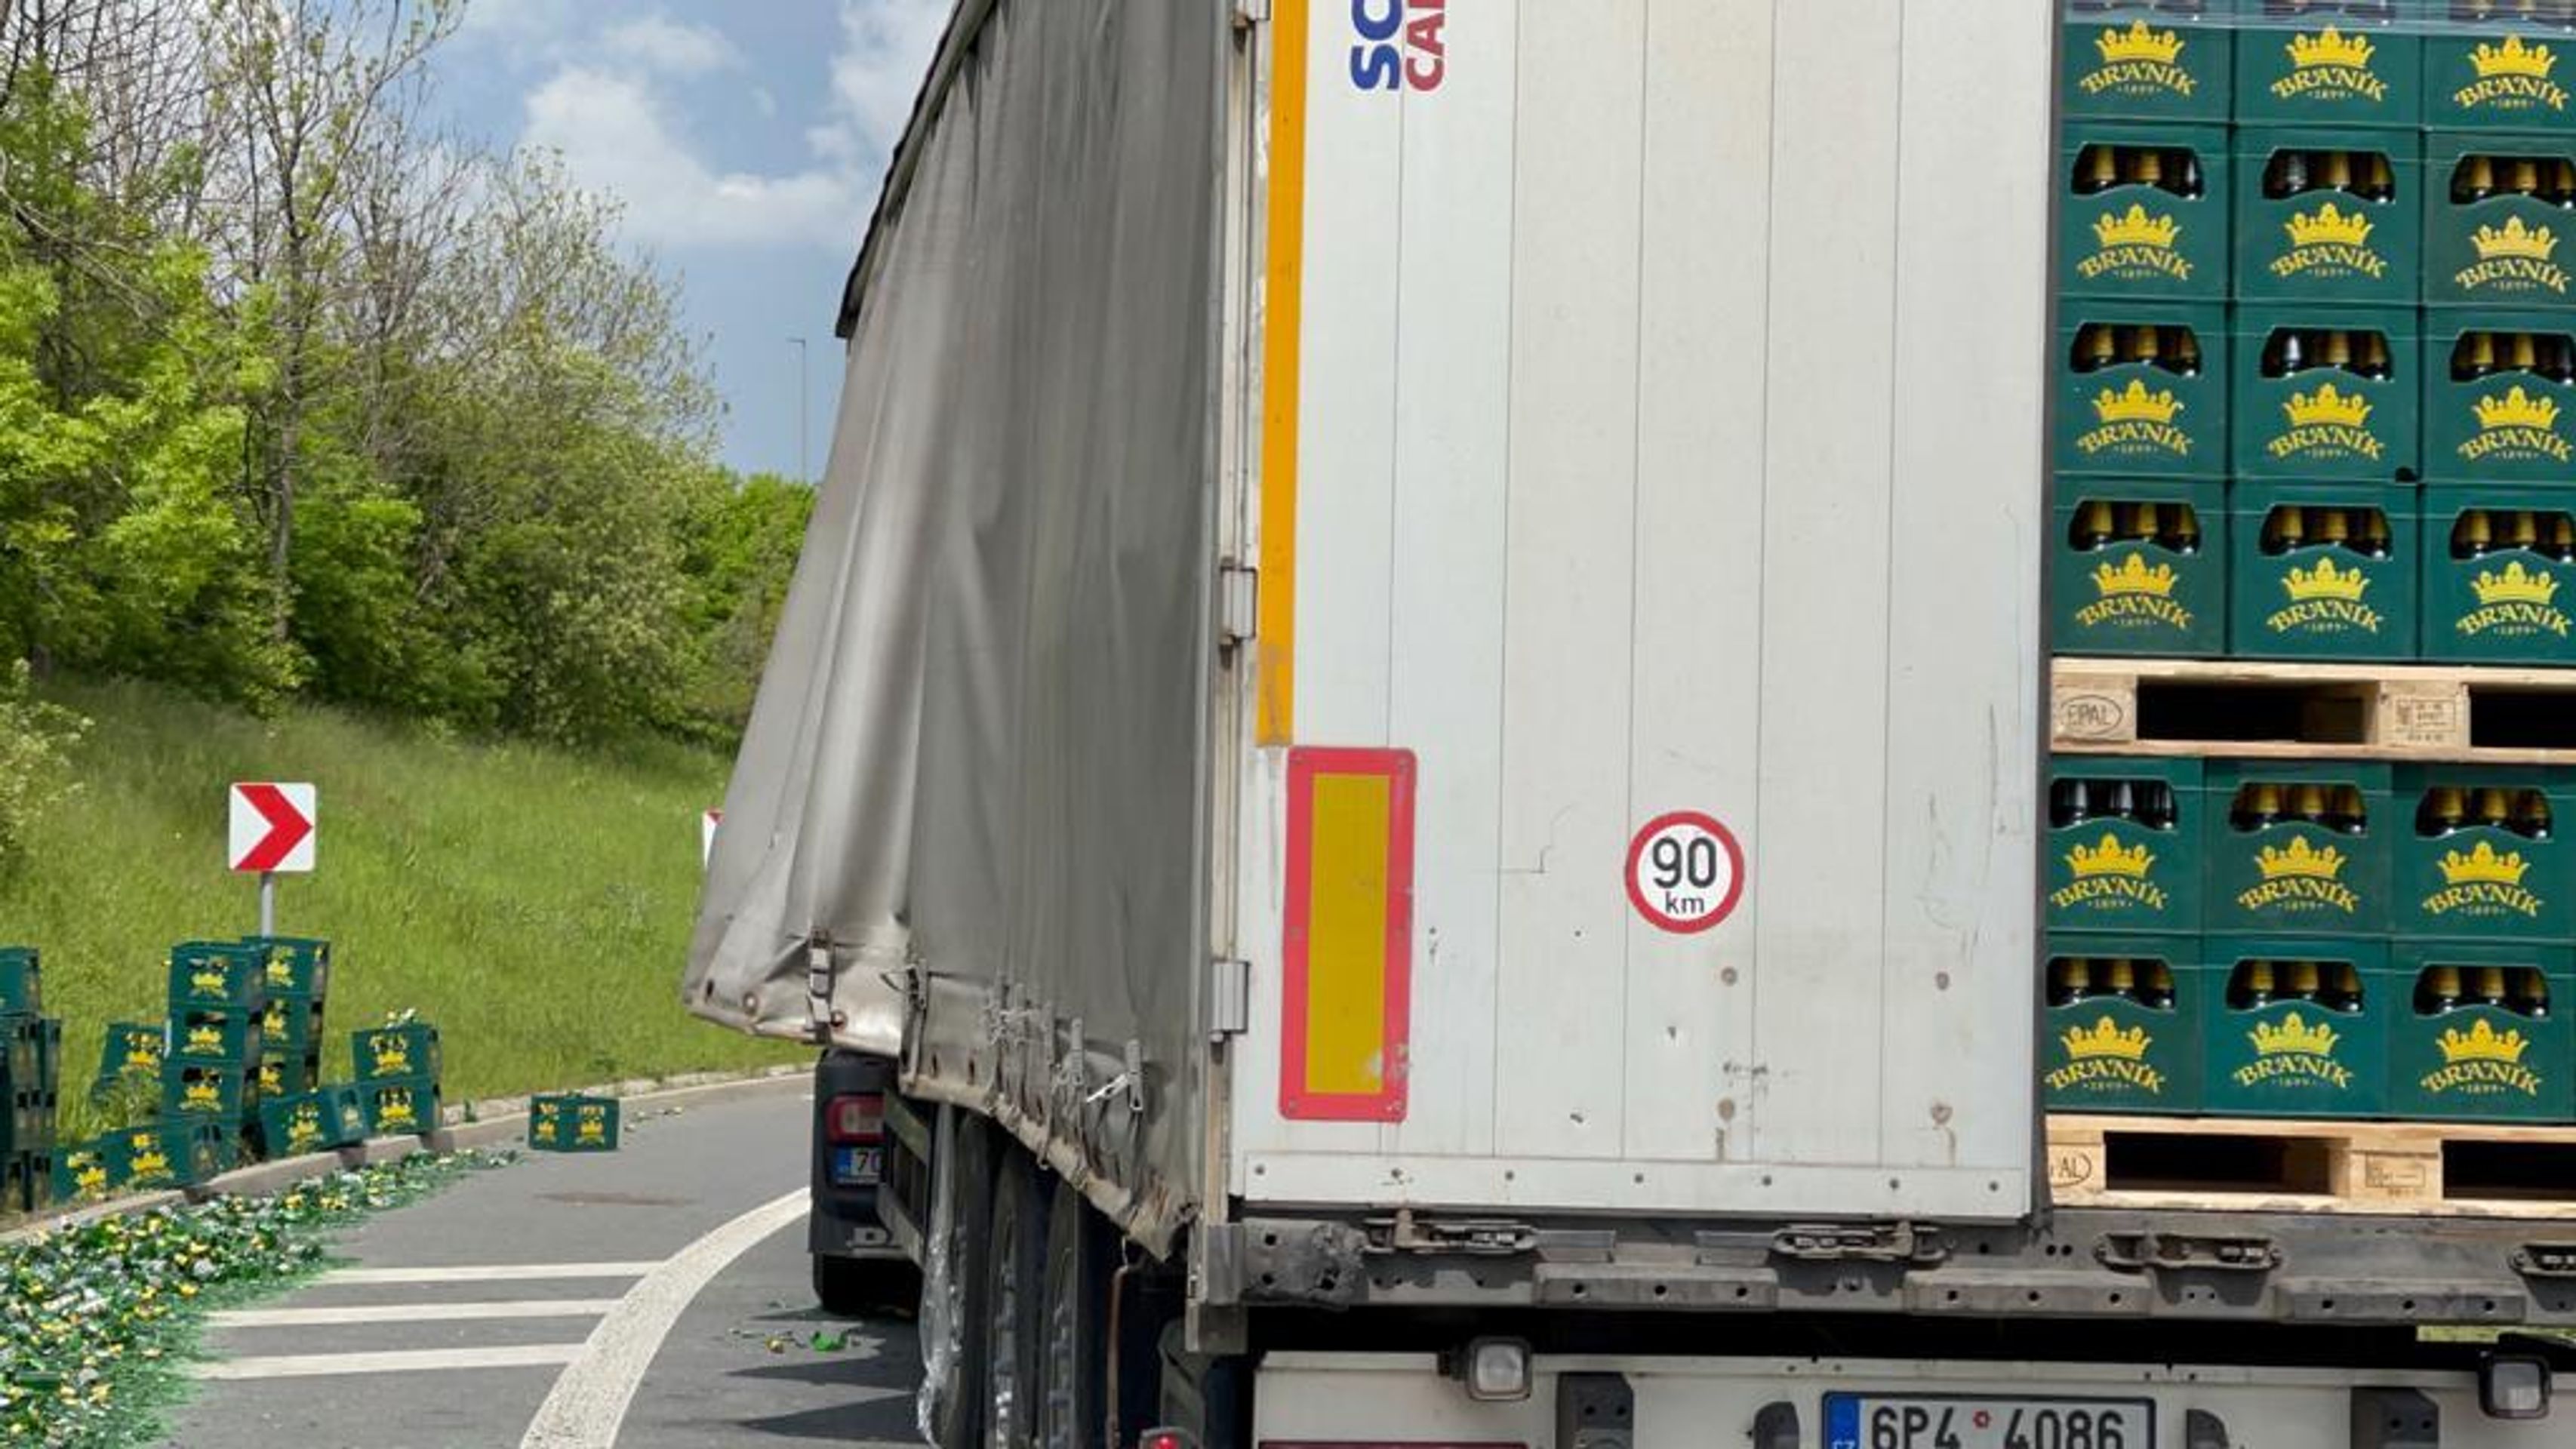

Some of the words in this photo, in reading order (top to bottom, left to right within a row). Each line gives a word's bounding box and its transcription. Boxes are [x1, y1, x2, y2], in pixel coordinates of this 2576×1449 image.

[1406, 0, 1445, 91] CA
[1652, 836, 1716, 888] 90
[1665, 891, 1705, 914] km
[1872, 1406, 1961, 1449] 6P4
[2004, 1408, 2124, 1449] 4086
